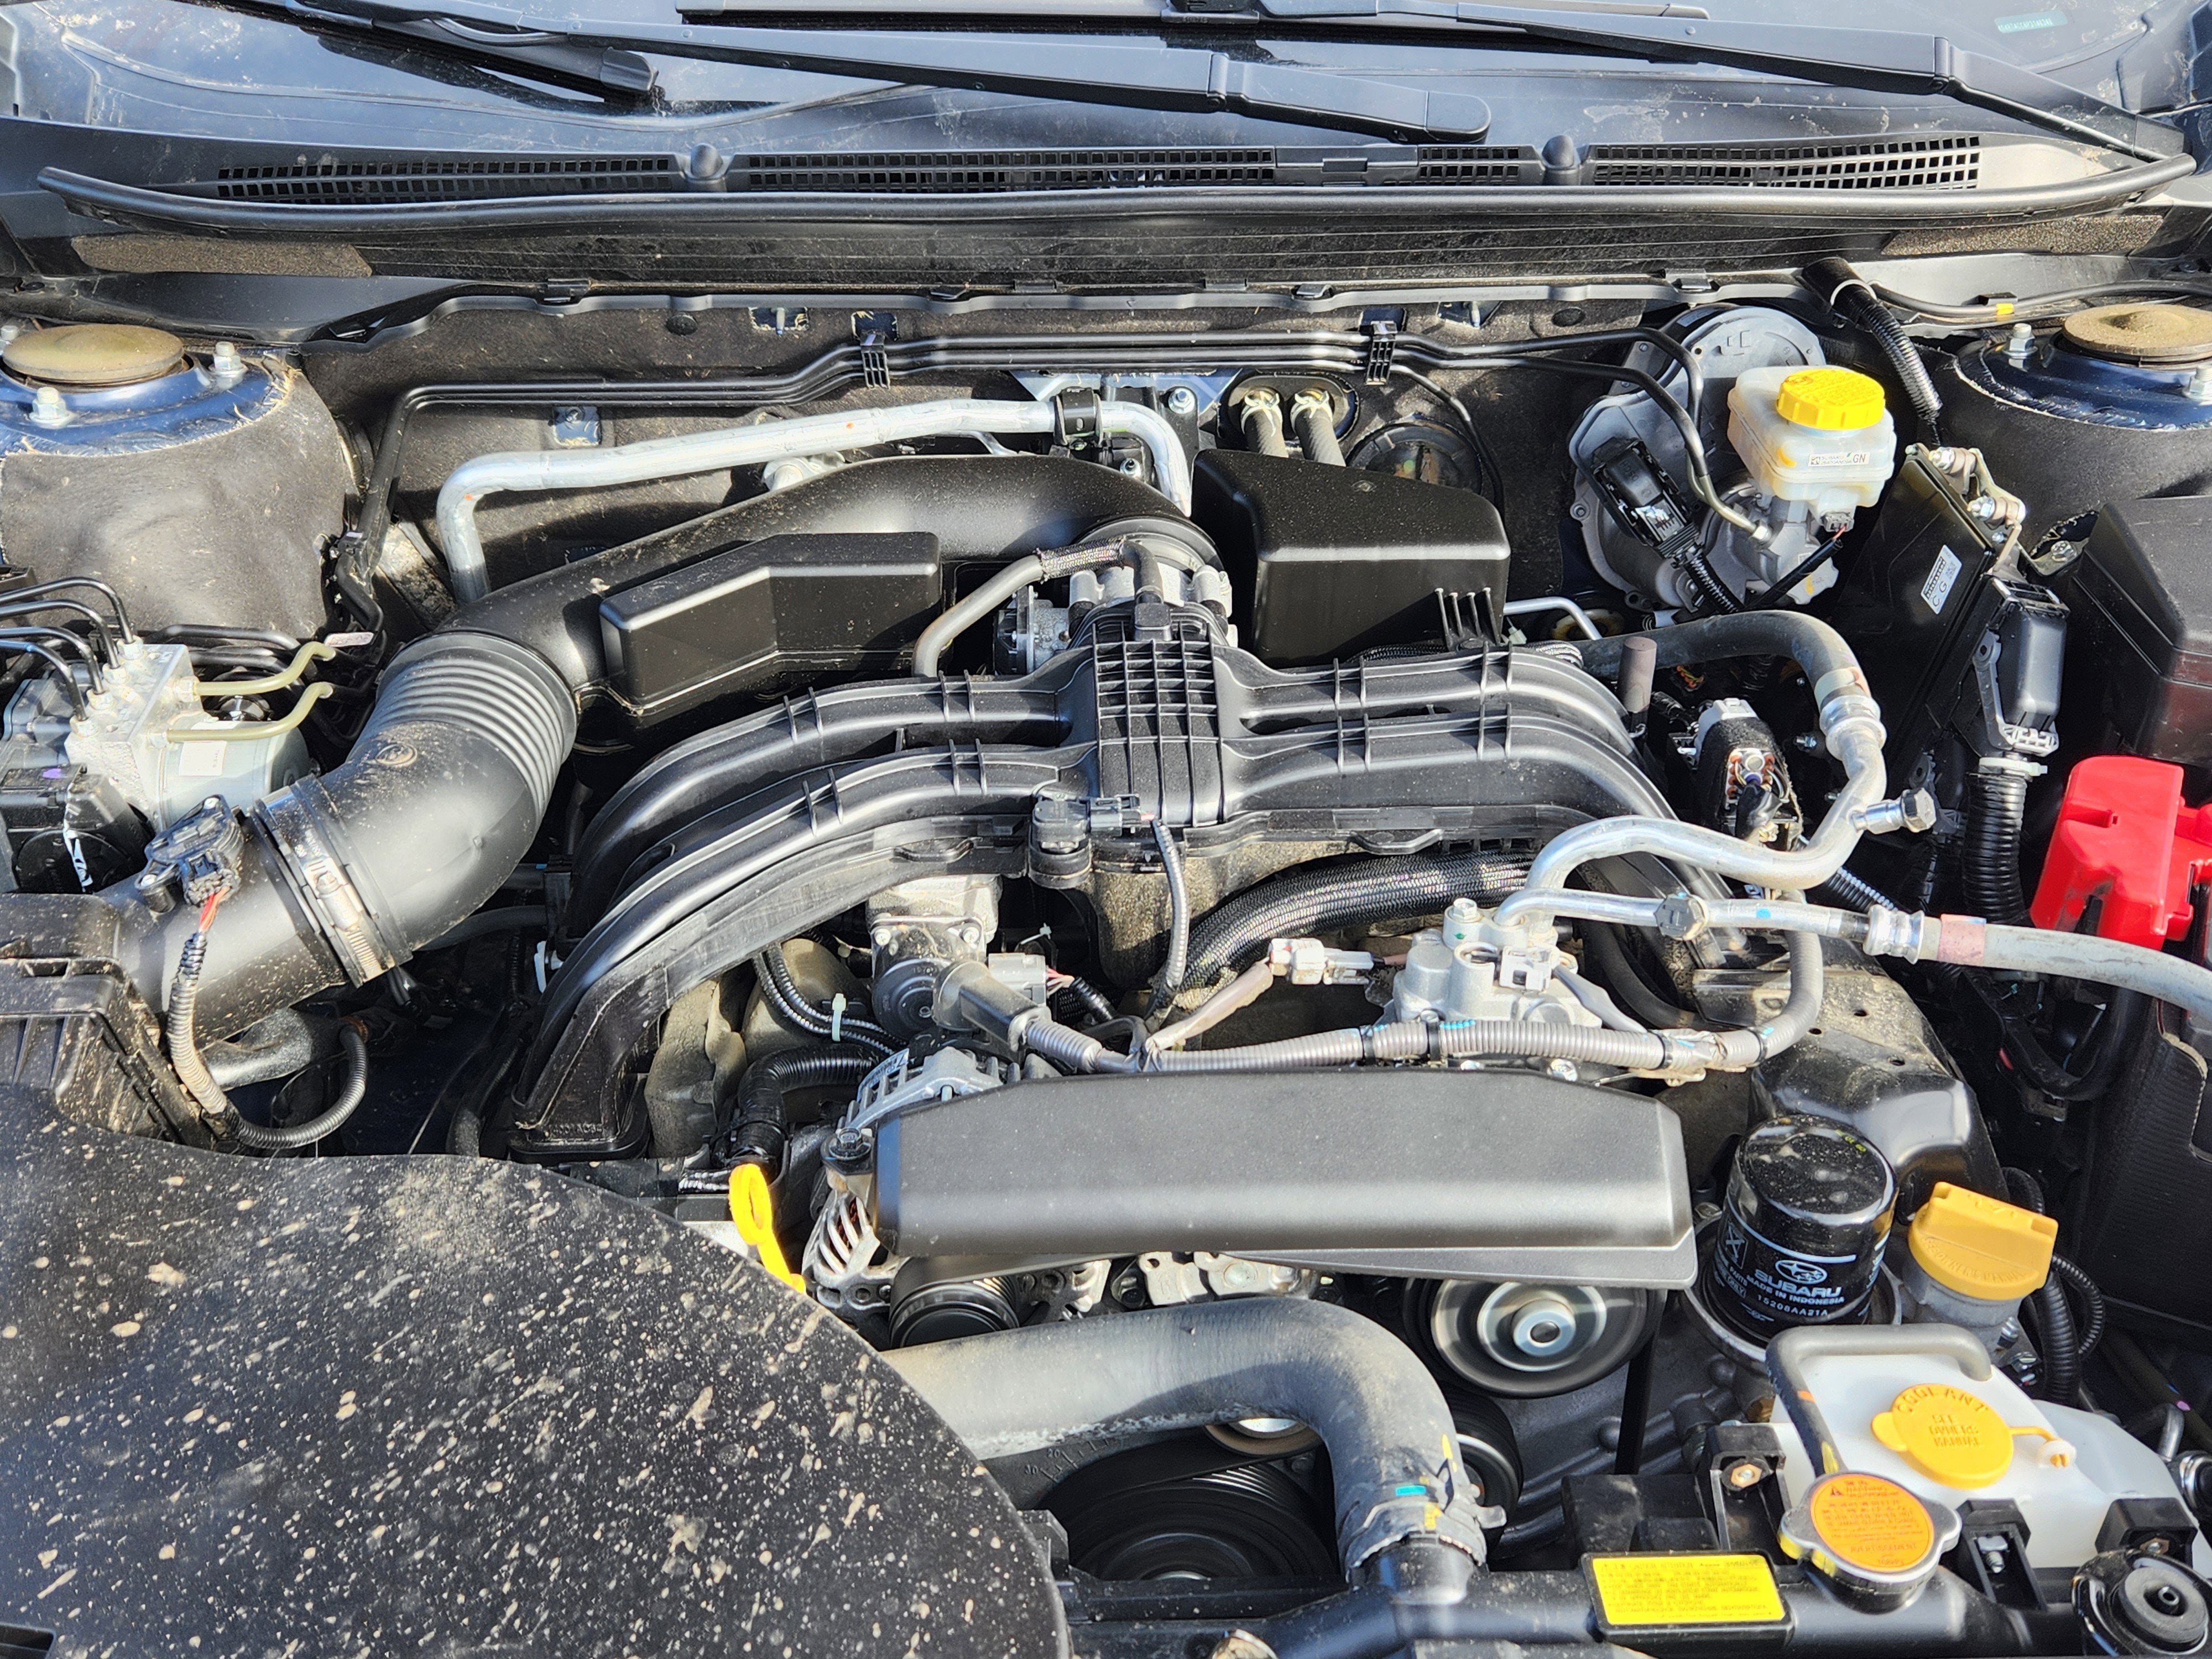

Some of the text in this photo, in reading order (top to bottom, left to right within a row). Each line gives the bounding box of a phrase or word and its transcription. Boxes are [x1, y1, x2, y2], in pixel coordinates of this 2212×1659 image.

[1853, 453, 1866, 463] GN
[1746, 1275, 1845, 1305] MADE IN INDONESIA
[1754, 1269, 1842, 1298] SUBARU
[1897, 1387, 1989, 1413] COOLANT
